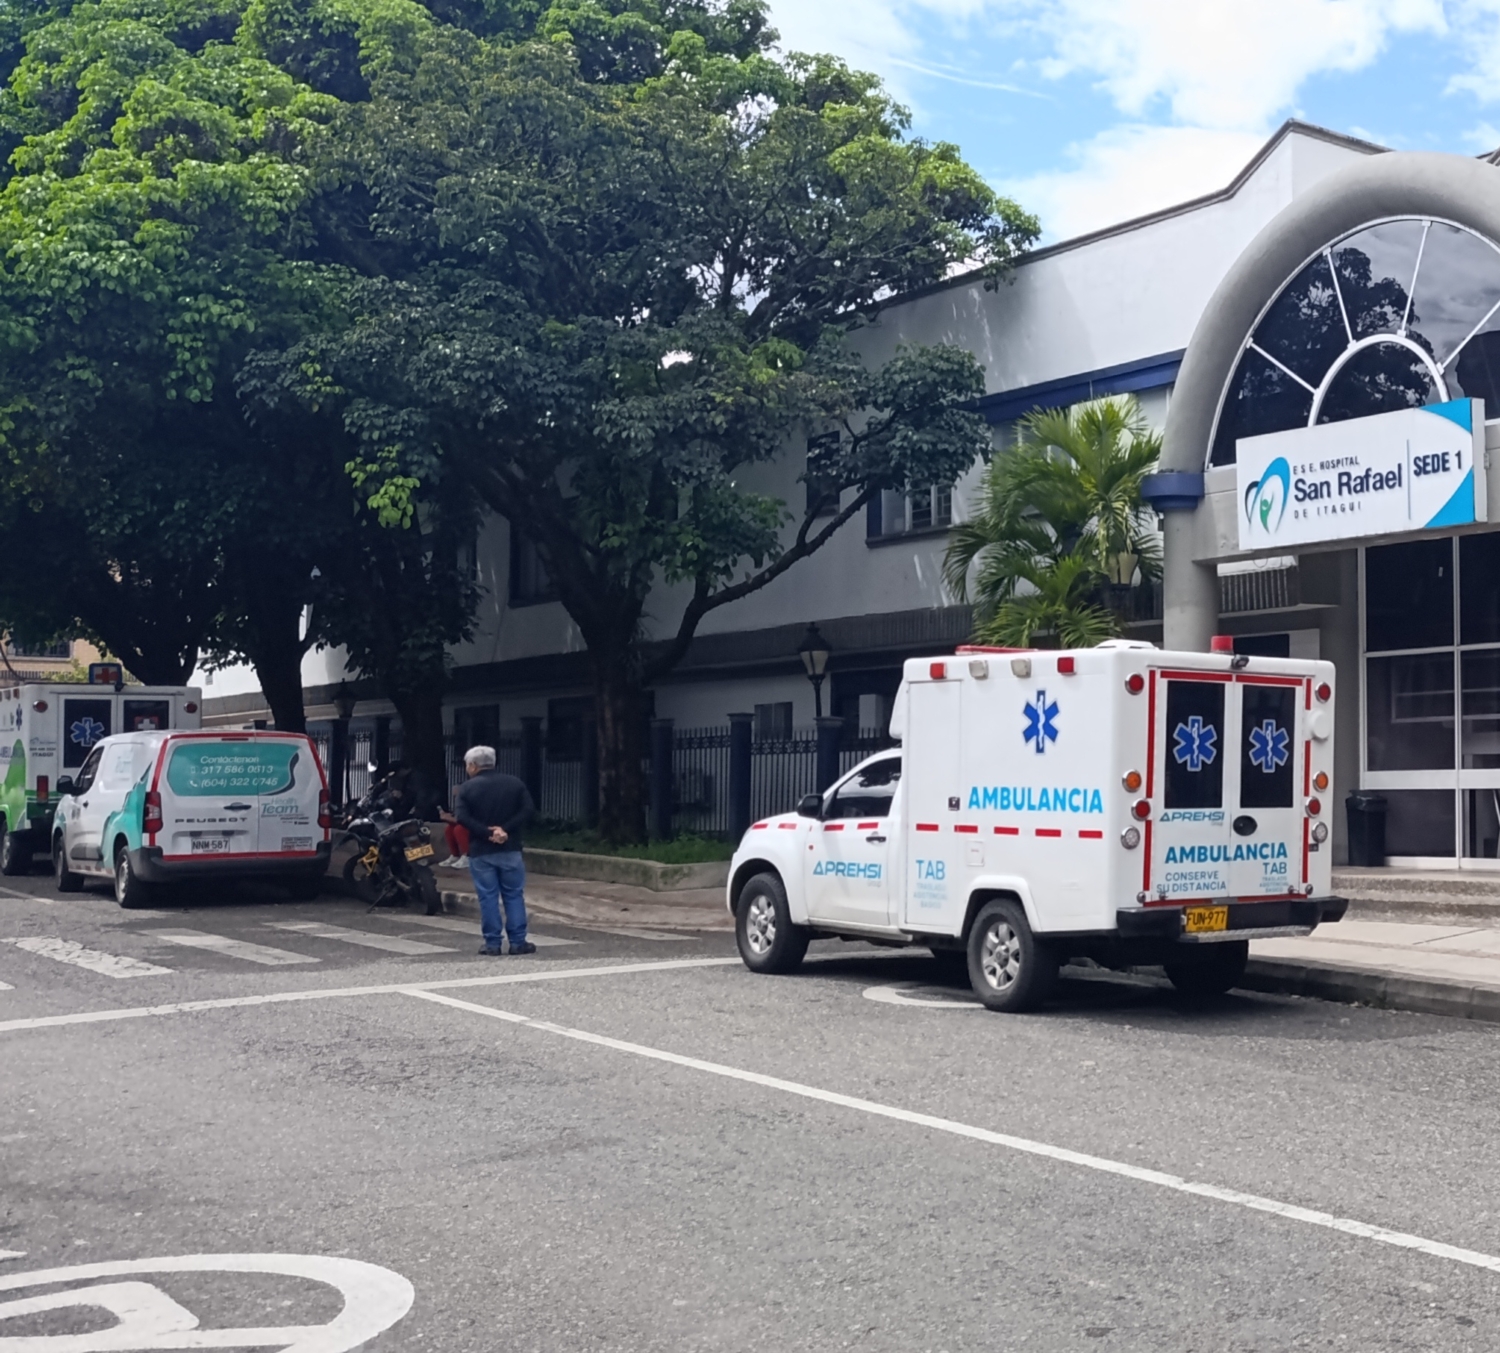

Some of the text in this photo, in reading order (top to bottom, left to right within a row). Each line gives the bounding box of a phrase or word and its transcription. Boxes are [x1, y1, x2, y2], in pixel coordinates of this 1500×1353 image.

[1319, 456, 1359, 471] HOSPITAL
[1413, 449, 1462, 477] SEDE 1
[1294, 462, 1402, 502] San Rafael
[1294, 508, 1308, 519] DE
[201, 765, 222, 775] 317
[224, 764, 245, 774] 586
[201, 778, 227, 788] (604)
[229, 777, 250, 786] 322
[968, 786, 1104, 813] AMBULANCIA
[261, 803, 299, 814] Team
[1159, 811, 1225, 822] APREHSI
[1164, 842, 1288, 864] AMBULANCIA
[813, 860, 882, 879] APREHSI
[915, 860, 946, 880] TAB
[1262, 861, 1288, 875] TAB
[1165, 871, 1219, 881] CONSERVE
[1156, 881, 1227, 893] SU DISTANCIA
